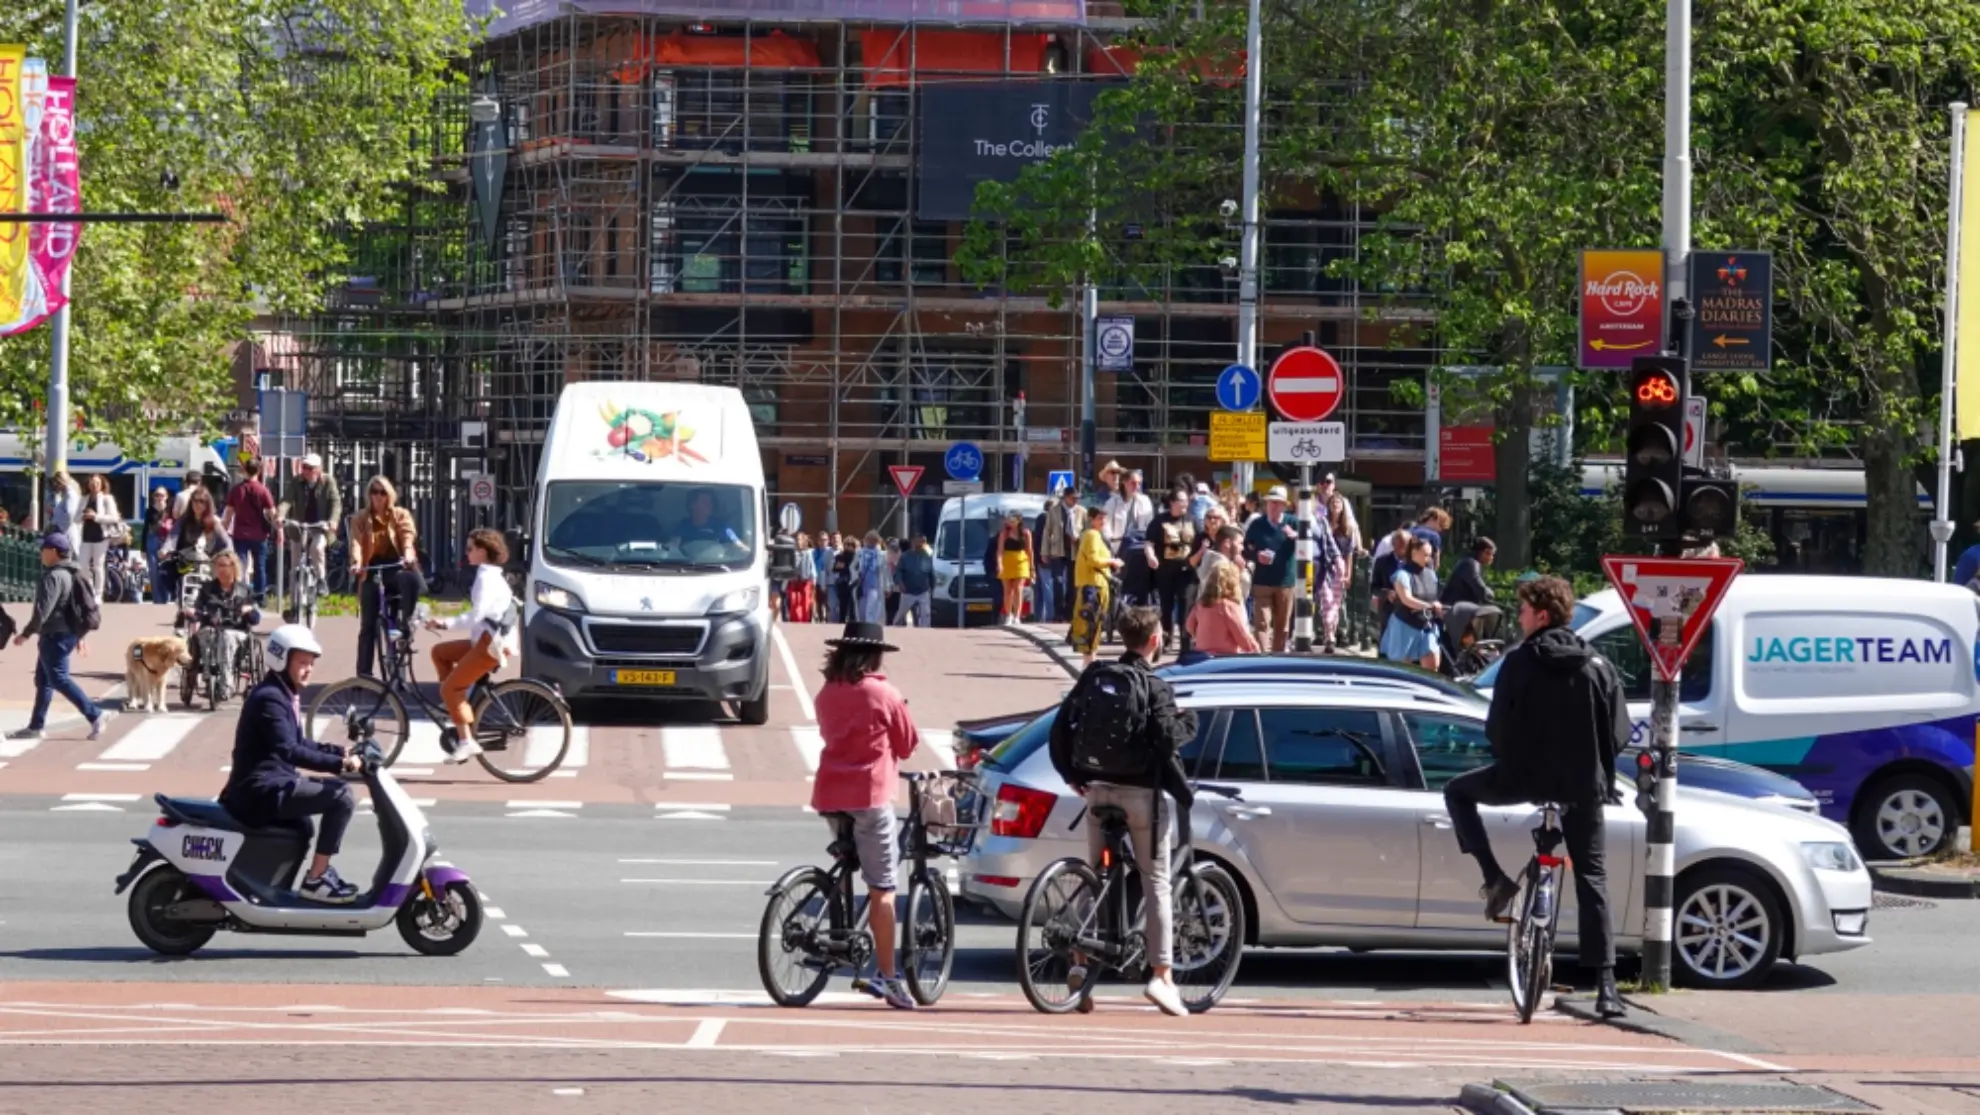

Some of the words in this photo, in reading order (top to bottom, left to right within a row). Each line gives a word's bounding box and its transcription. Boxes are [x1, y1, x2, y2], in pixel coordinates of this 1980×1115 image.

[974, 139, 1007, 156] The
[1585, 281, 1623, 296] Hard
[1624, 281, 1660, 299] Rock
[1722, 287, 1743, 296] THE
[1702, 297, 1763, 310] MADRAS
[1702, 310, 1762, 323] DIARIES
[1599, 323, 1644, 331] AMSTERDAM
[1273, 426, 1340, 436] uitgezonderd
[1748, 637, 1952, 663] JAGERTEAM
